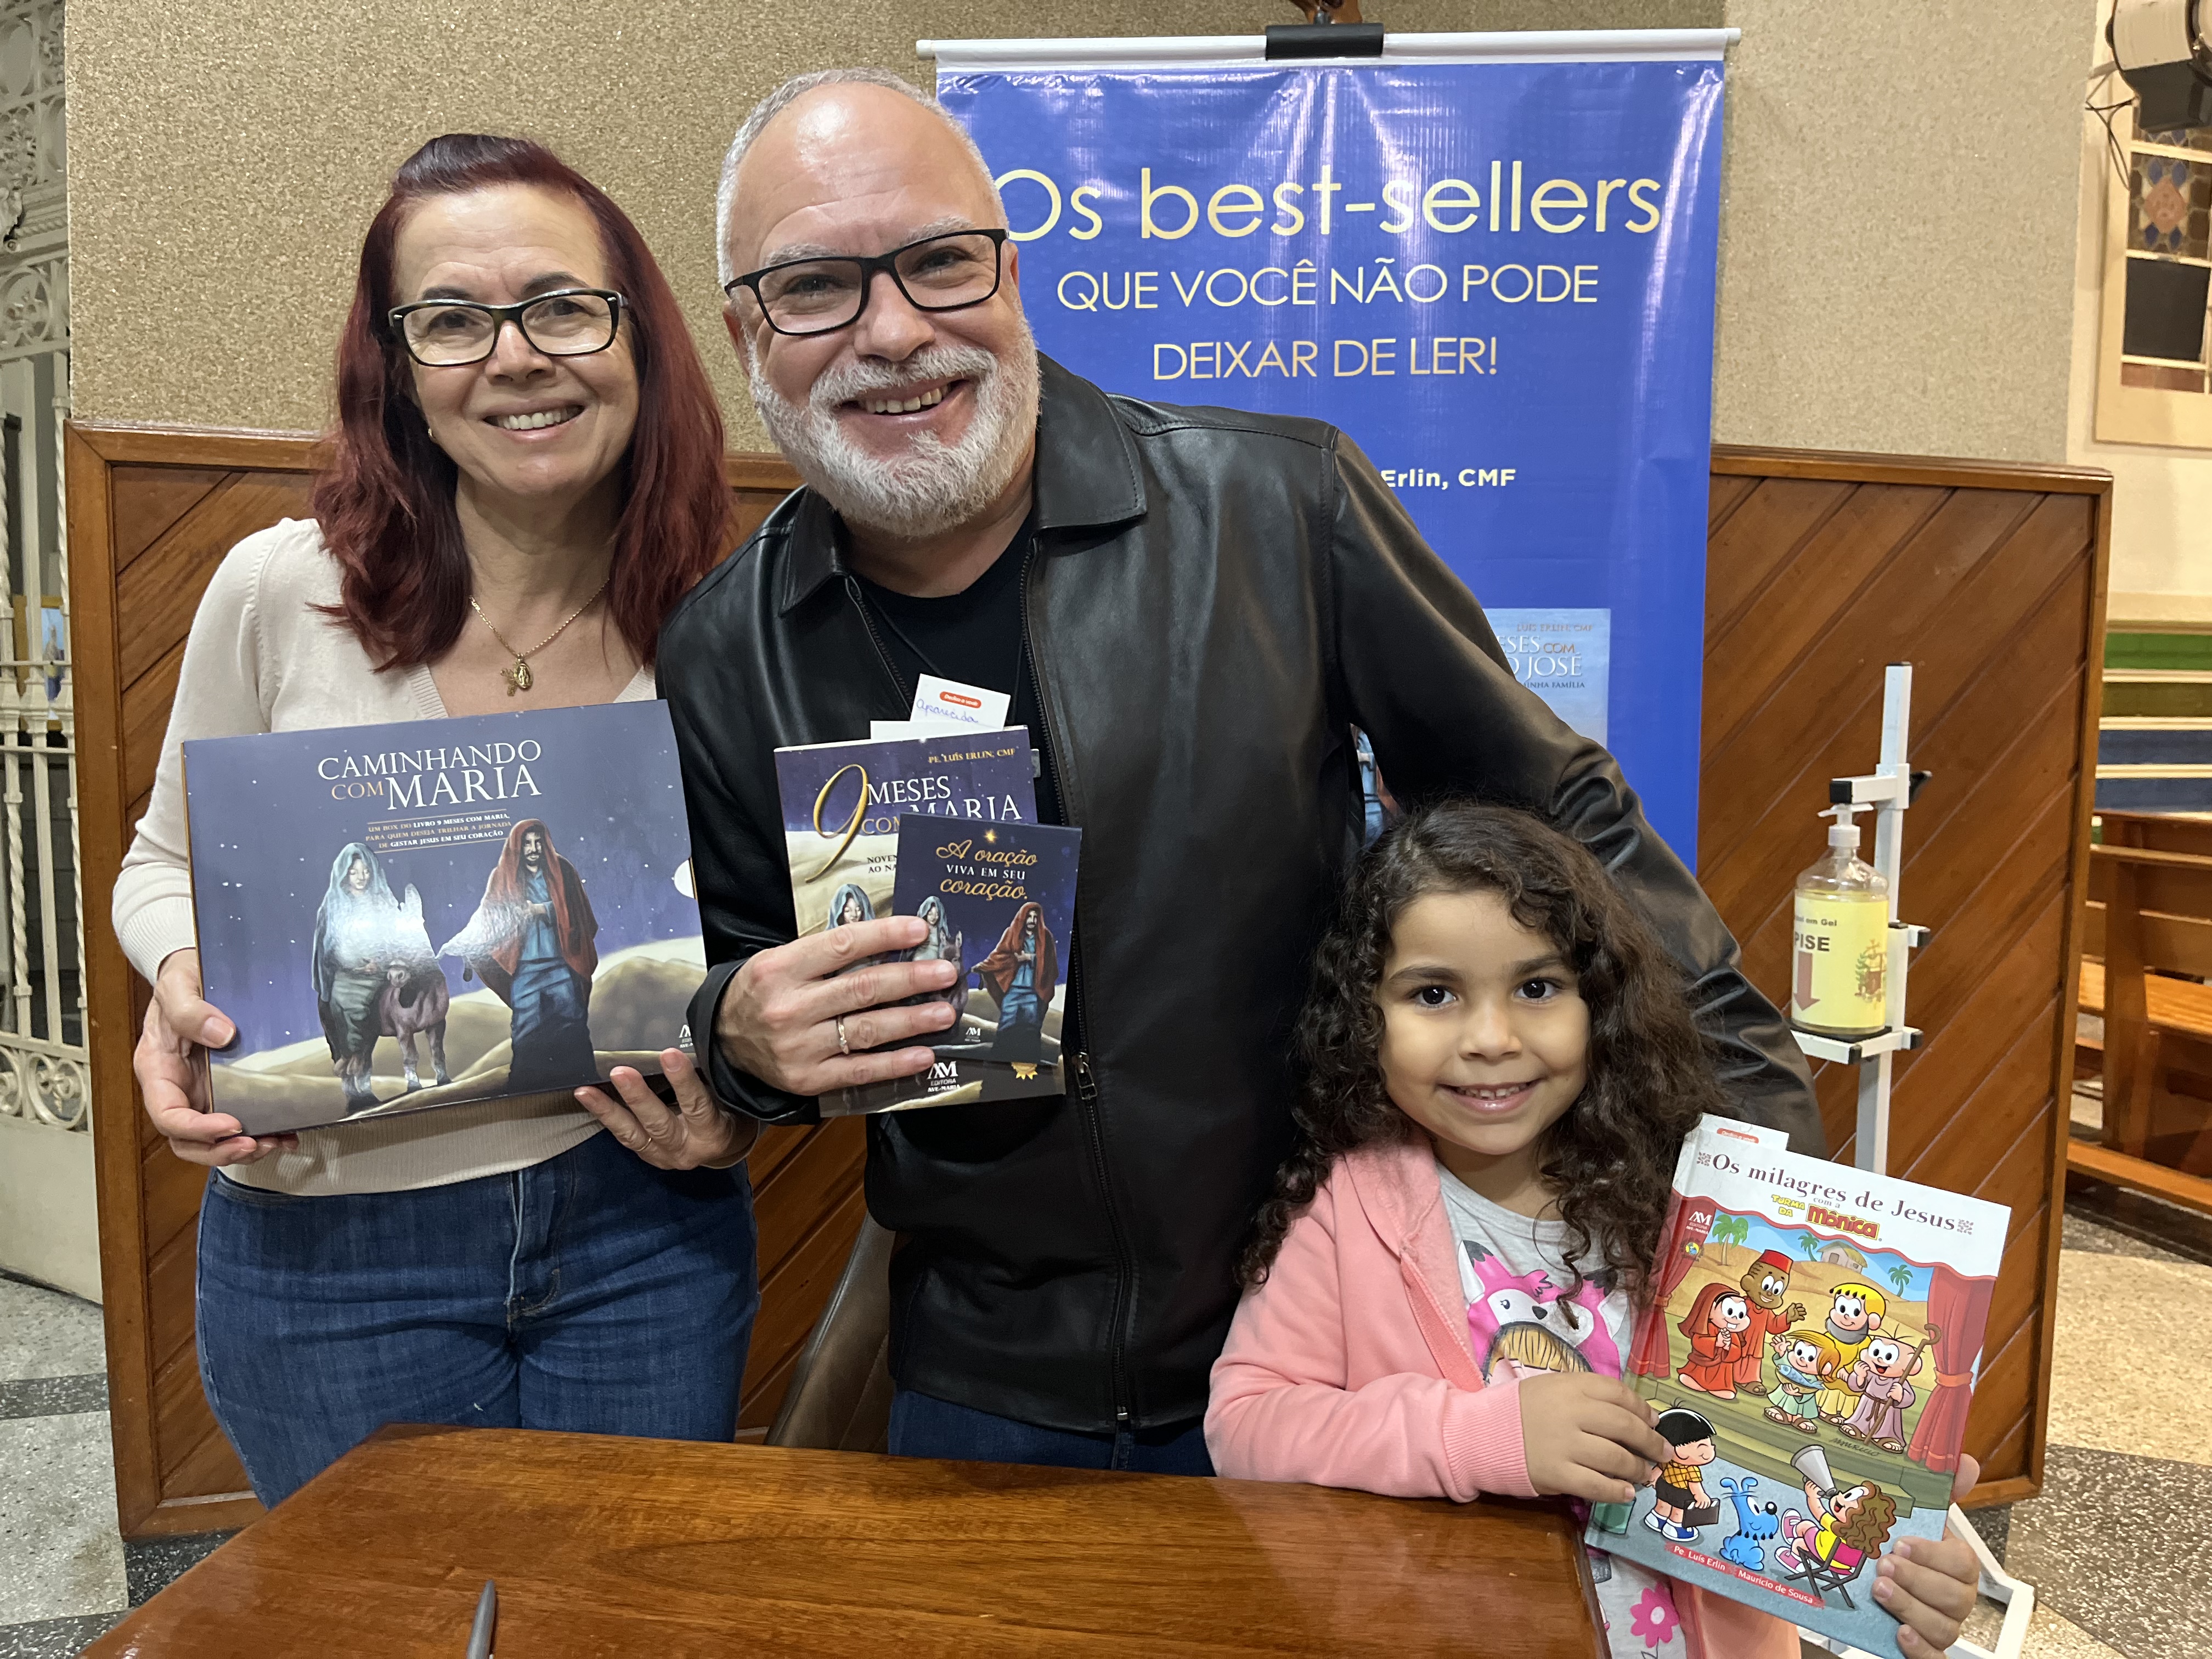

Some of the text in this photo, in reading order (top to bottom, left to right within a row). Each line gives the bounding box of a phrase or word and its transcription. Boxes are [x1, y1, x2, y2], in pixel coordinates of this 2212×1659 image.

[994, 161, 1661, 241] Os best-sellers
[1057, 257, 1599, 312] QUE VOCÊ NÃO PODE
[1154, 336, 1497, 380] DEIXAR DE LER!
[1381, 469, 1516, 490] Erlin, CMF
[1497, 635, 1575, 654] ESES COM
[1525, 652, 1583, 682] JOSÉ
[318, 740, 542, 780] CAMINHANDO
[331, 764, 542, 810] COM MARIA
[387, 832, 409, 840] QUEM
[478, 821, 512, 831] JORNADA
[413, 820, 436, 828] LIVRO
[805, 763, 952, 884] 9 MESES
[390, 839, 419, 848] GESTAR
[420, 837, 439, 845] JESUS
[468, 830, 504, 839] CORAÇÃO
[974, 849, 1038, 867] oração
[868, 865, 882, 874] AO
[946, 864, 1026, 881] VIVA EM SEU
[930, 1077, 957, 1086] EDITORA
[1712, 1153, 1955, 1231] Os milagres de Jesus
[1813, 1197, 1832, 1206] com
[1770, 1194, 1805, 1211] TURMA
[1778, 1206, 1793, 1217] DA
[1688, 1550, 1705, 1564] Luís
[1706, 1558, 1726, 1571] Erlin
[1737, 1569, 1814, 1604] Mauricio de Sousa
